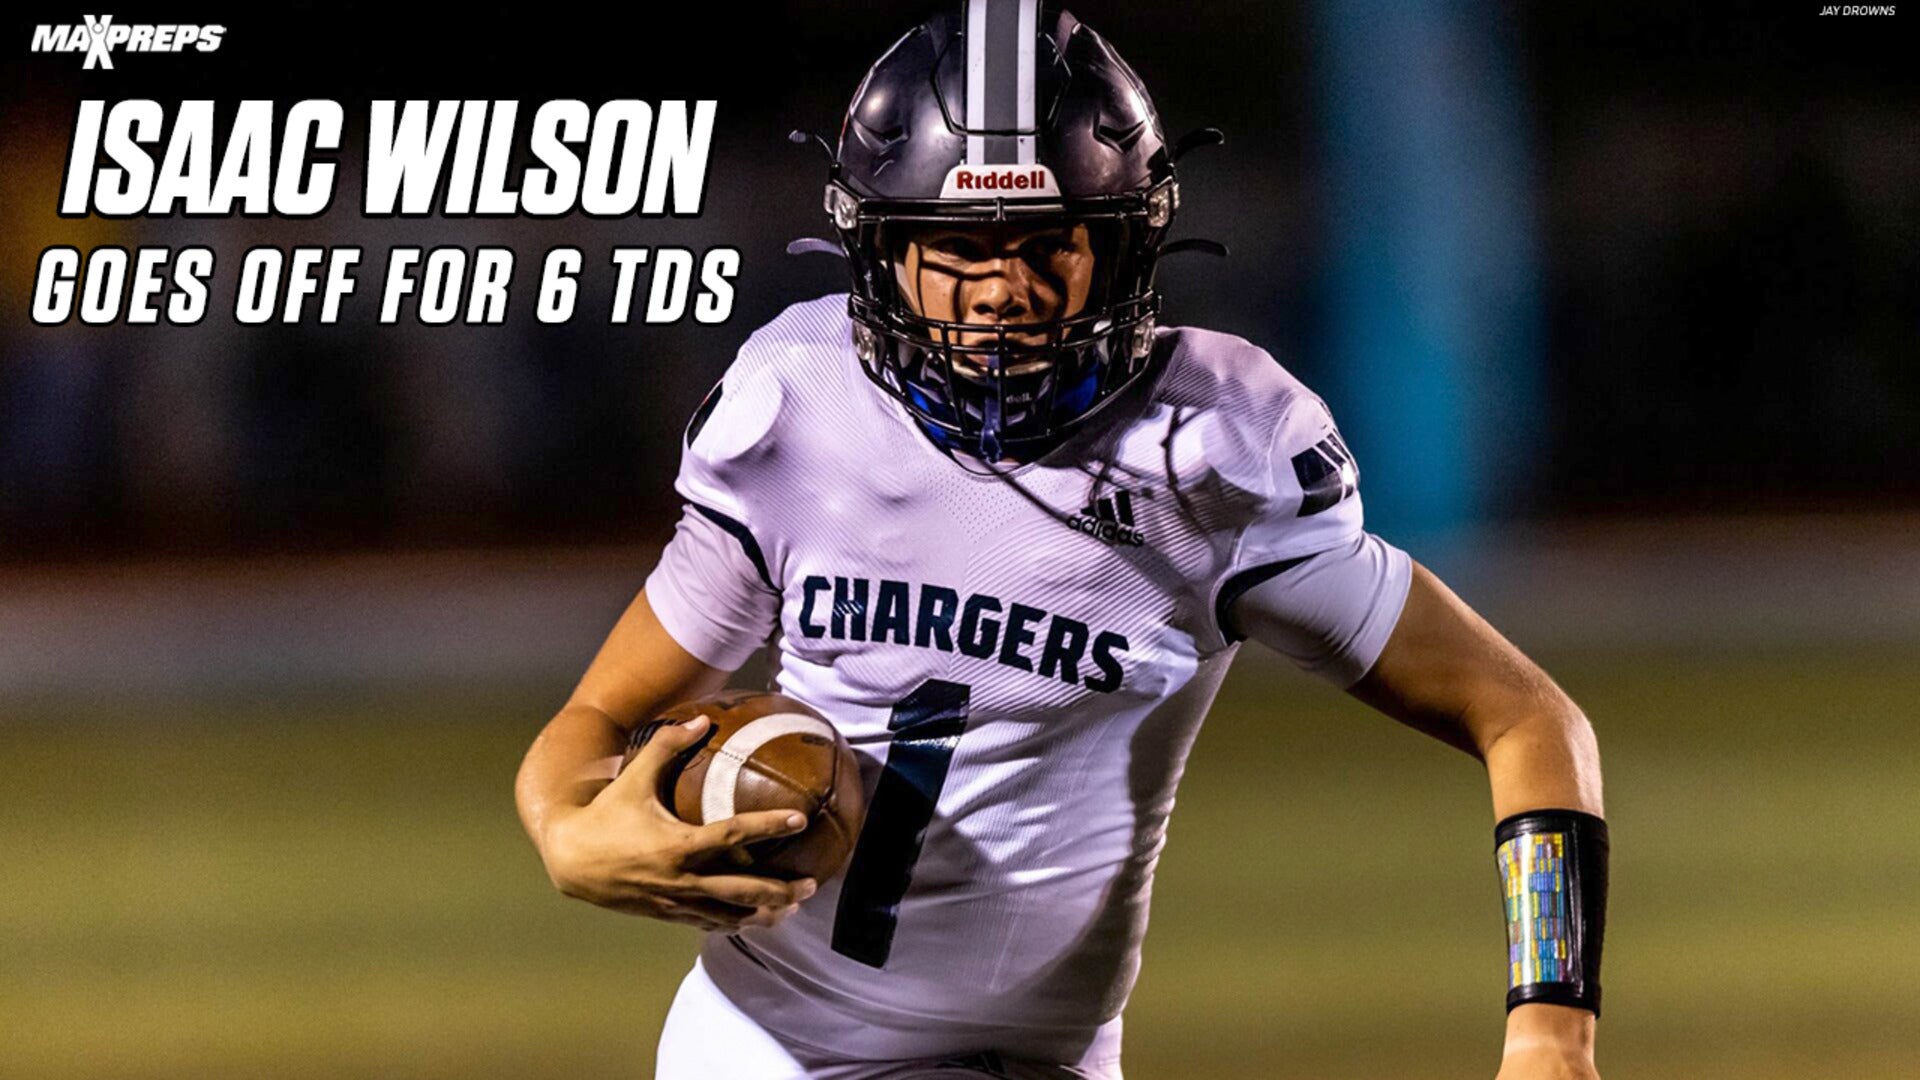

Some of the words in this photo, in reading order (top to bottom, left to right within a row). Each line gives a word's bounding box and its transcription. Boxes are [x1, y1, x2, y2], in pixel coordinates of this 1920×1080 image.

[956, 170, 1046, 191] Riddell
[1066, 514, 1145, 548] adidas
[799, 575, 1130, 694] CHARGERS
[830, 678, 971, 969] 1
